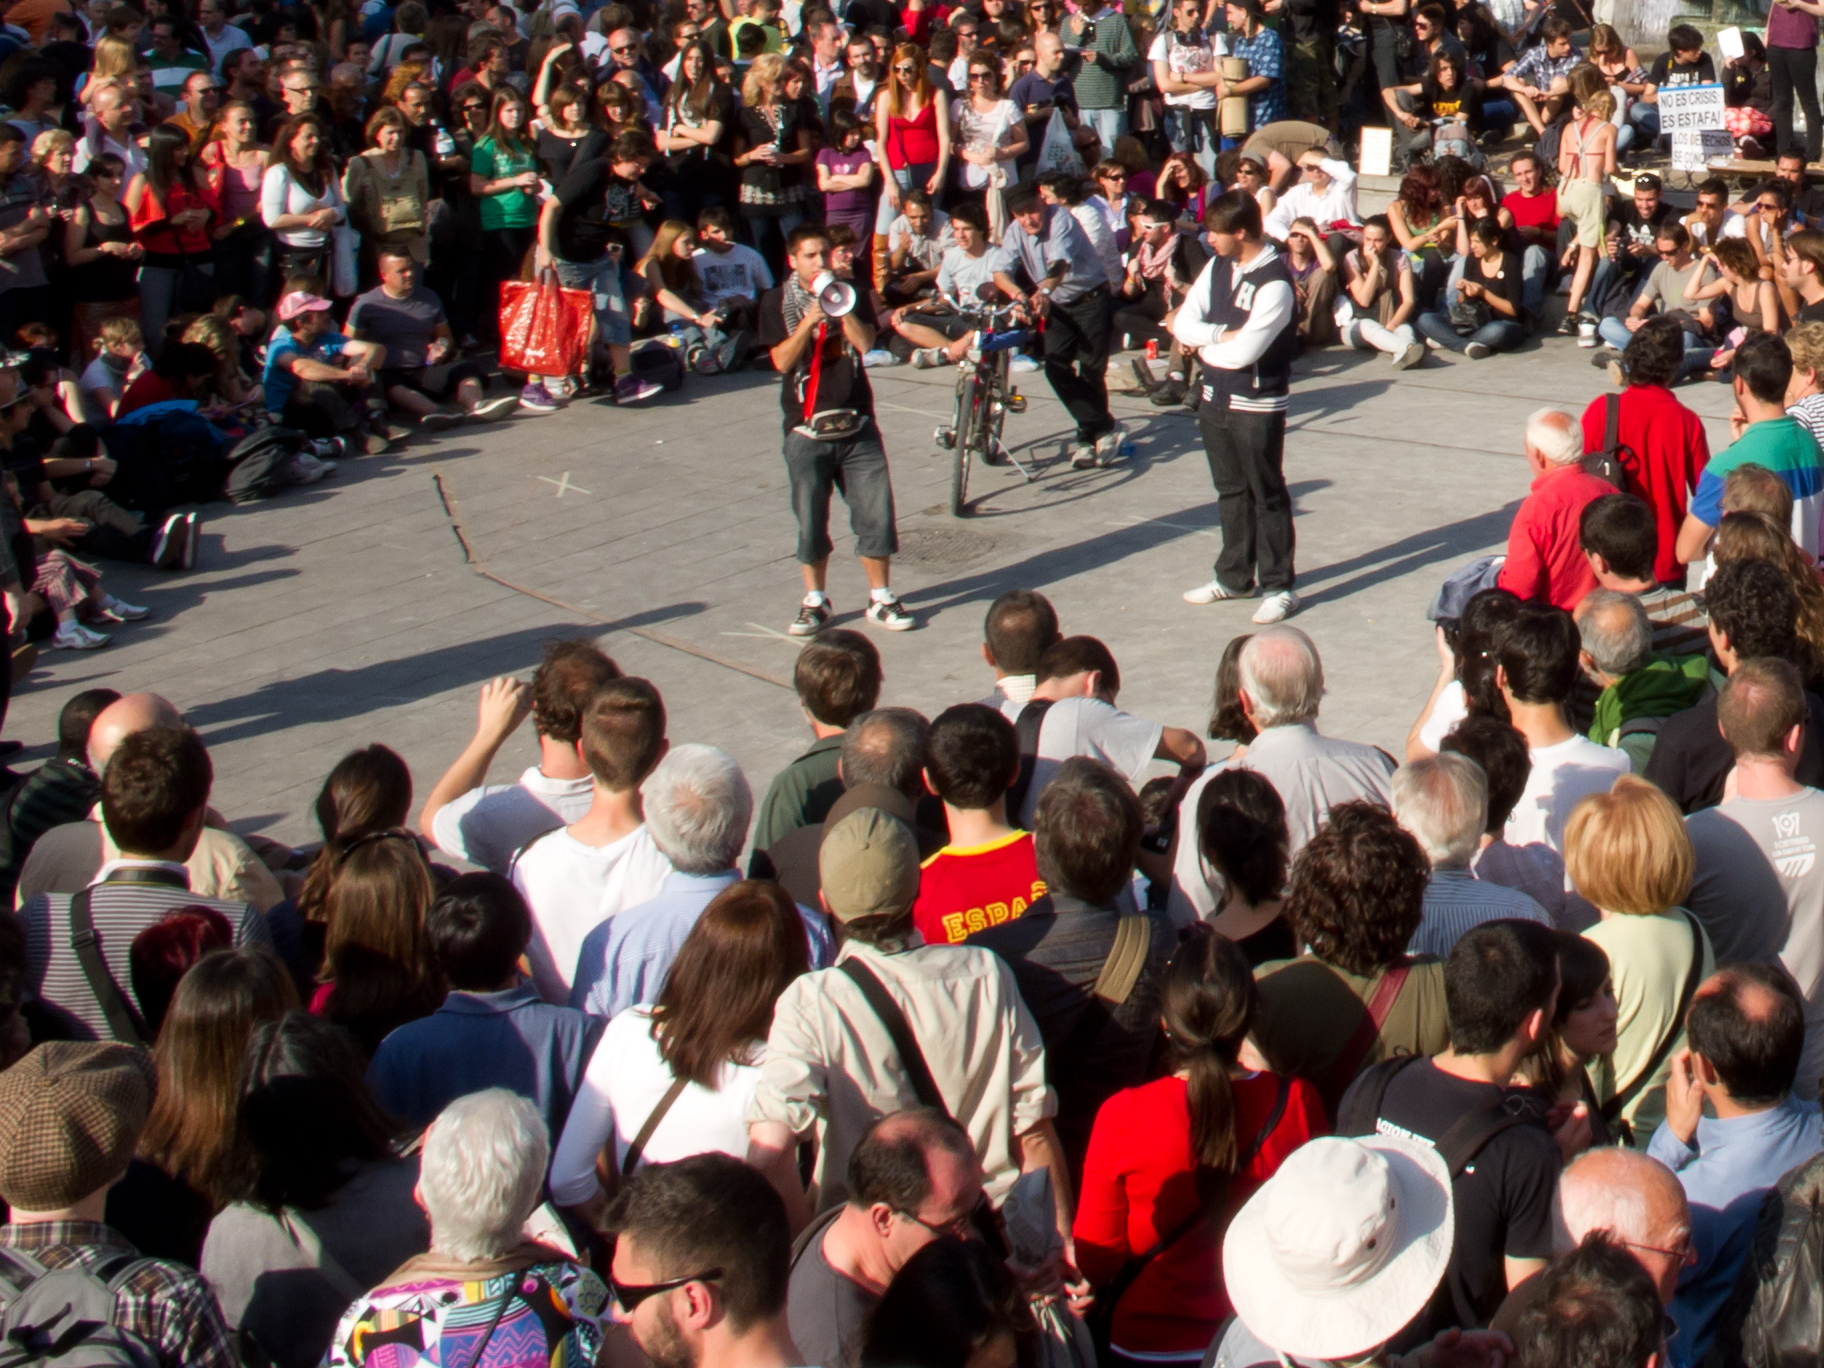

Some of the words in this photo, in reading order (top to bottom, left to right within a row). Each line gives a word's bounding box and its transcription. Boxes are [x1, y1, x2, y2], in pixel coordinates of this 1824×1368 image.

[1660, 94, 1674, 109] NO
[1676, 93, 1687, 106] ES
[1662, 114, 1675, 129] ES
[1678, 111, 1721, 127] ESTAFA!
[1674, 133, 1688, 146] LOS
[1690, 133, 1731, 147] DERECHOS
[1674, 151, 1683, 163] SE
[1235, 281, 1256, 311] H
